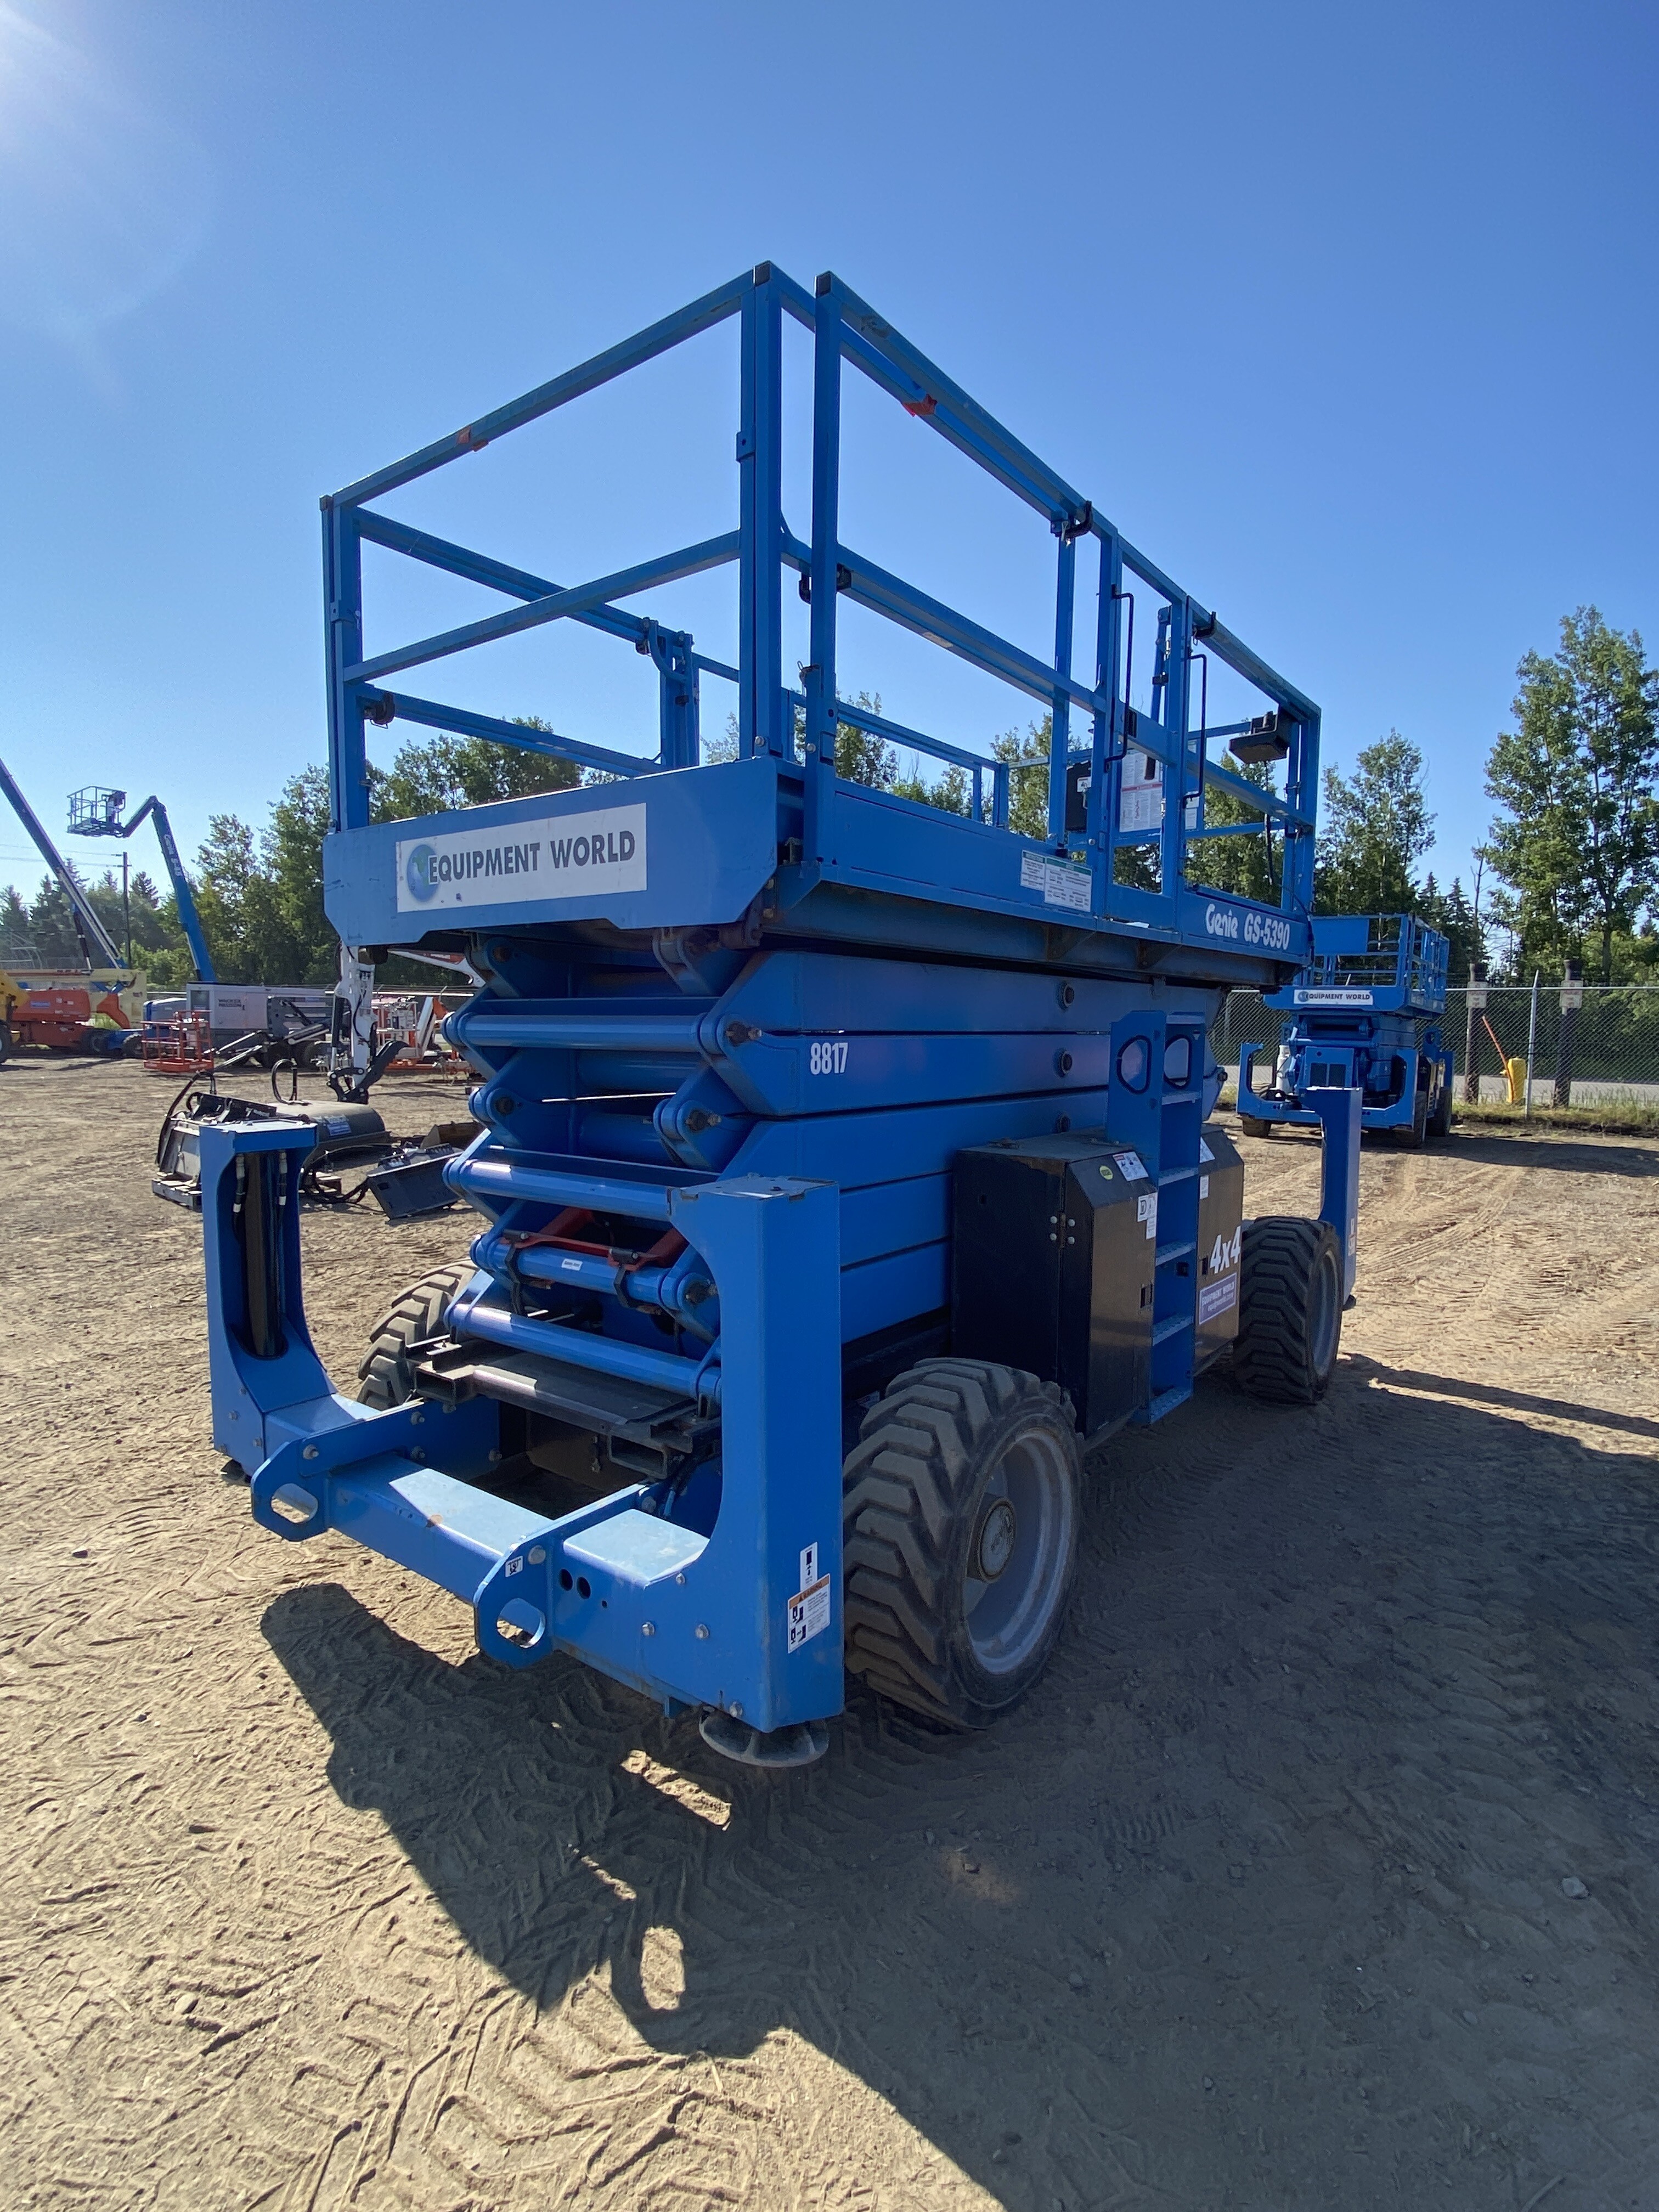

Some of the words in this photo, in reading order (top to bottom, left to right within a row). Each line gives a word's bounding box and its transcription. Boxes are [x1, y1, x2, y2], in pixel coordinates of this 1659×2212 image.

[429, 842, 540, 882] EQUIPMENT
[550, 831, 635, 868] WORLD
[1206, 903, 1239, 939] Genie
[1244, 913, 1290, 950] GS-5390
[810, 1042, 848, 1075] 8817
[1210, 1225, 1241, 1275] 4x4
